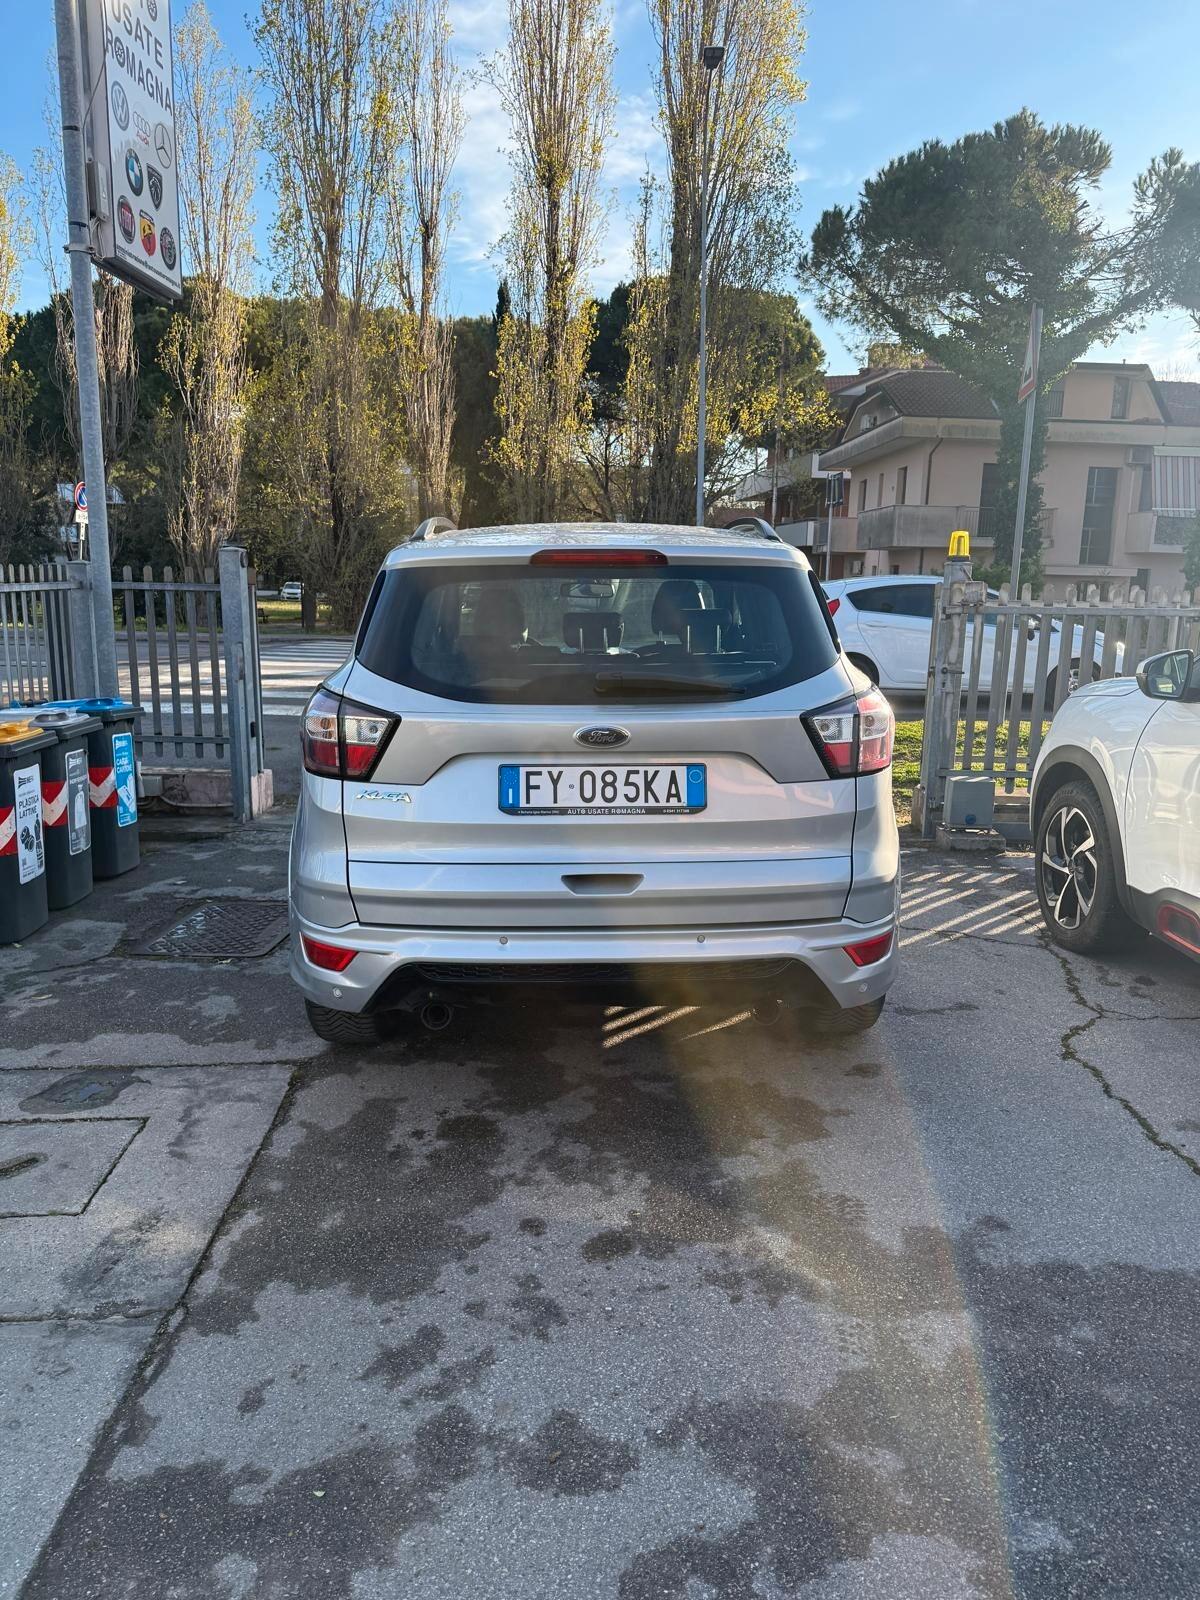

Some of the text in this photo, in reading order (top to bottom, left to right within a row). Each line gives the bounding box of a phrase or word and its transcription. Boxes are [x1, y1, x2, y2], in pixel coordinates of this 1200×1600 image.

[112, 0, 163, 70] USATE
[106, 25, 172, 116] ROMAGNA
[588, 730, 617, 743] Ford
[525, 770, 683, 804] FY 085KA
